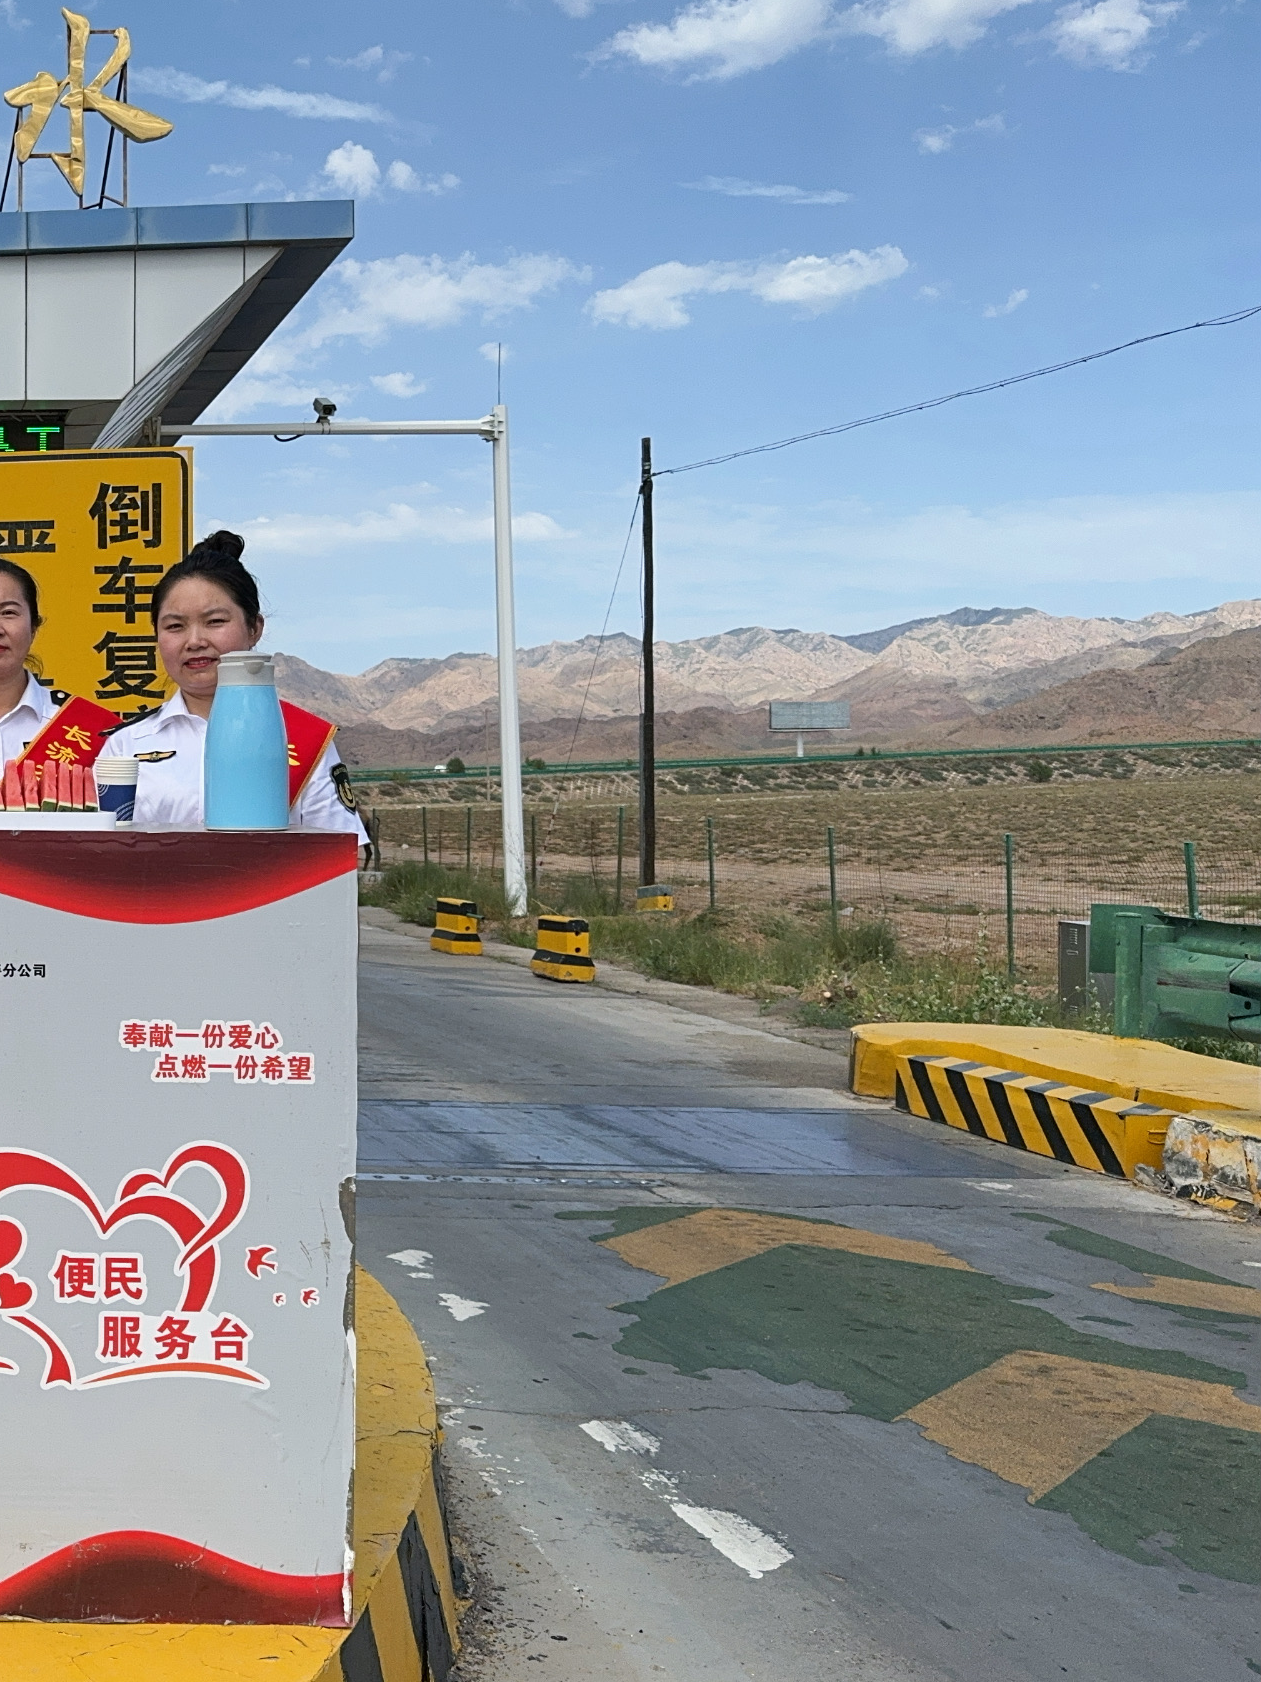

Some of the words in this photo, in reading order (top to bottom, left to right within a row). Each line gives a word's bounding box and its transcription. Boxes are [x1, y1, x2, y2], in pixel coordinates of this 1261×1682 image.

[89, 482, 165, 723] 倒车复
[35, 724, 92, 781] 长流
[123, 1022, 279, 1050] 奉献一份爱心
[155, 1054, 312, 1080] 点燃一份希望
[54, 1255, 143, 1299] 便民
[101, 1316, 248, 1361] 服务台
